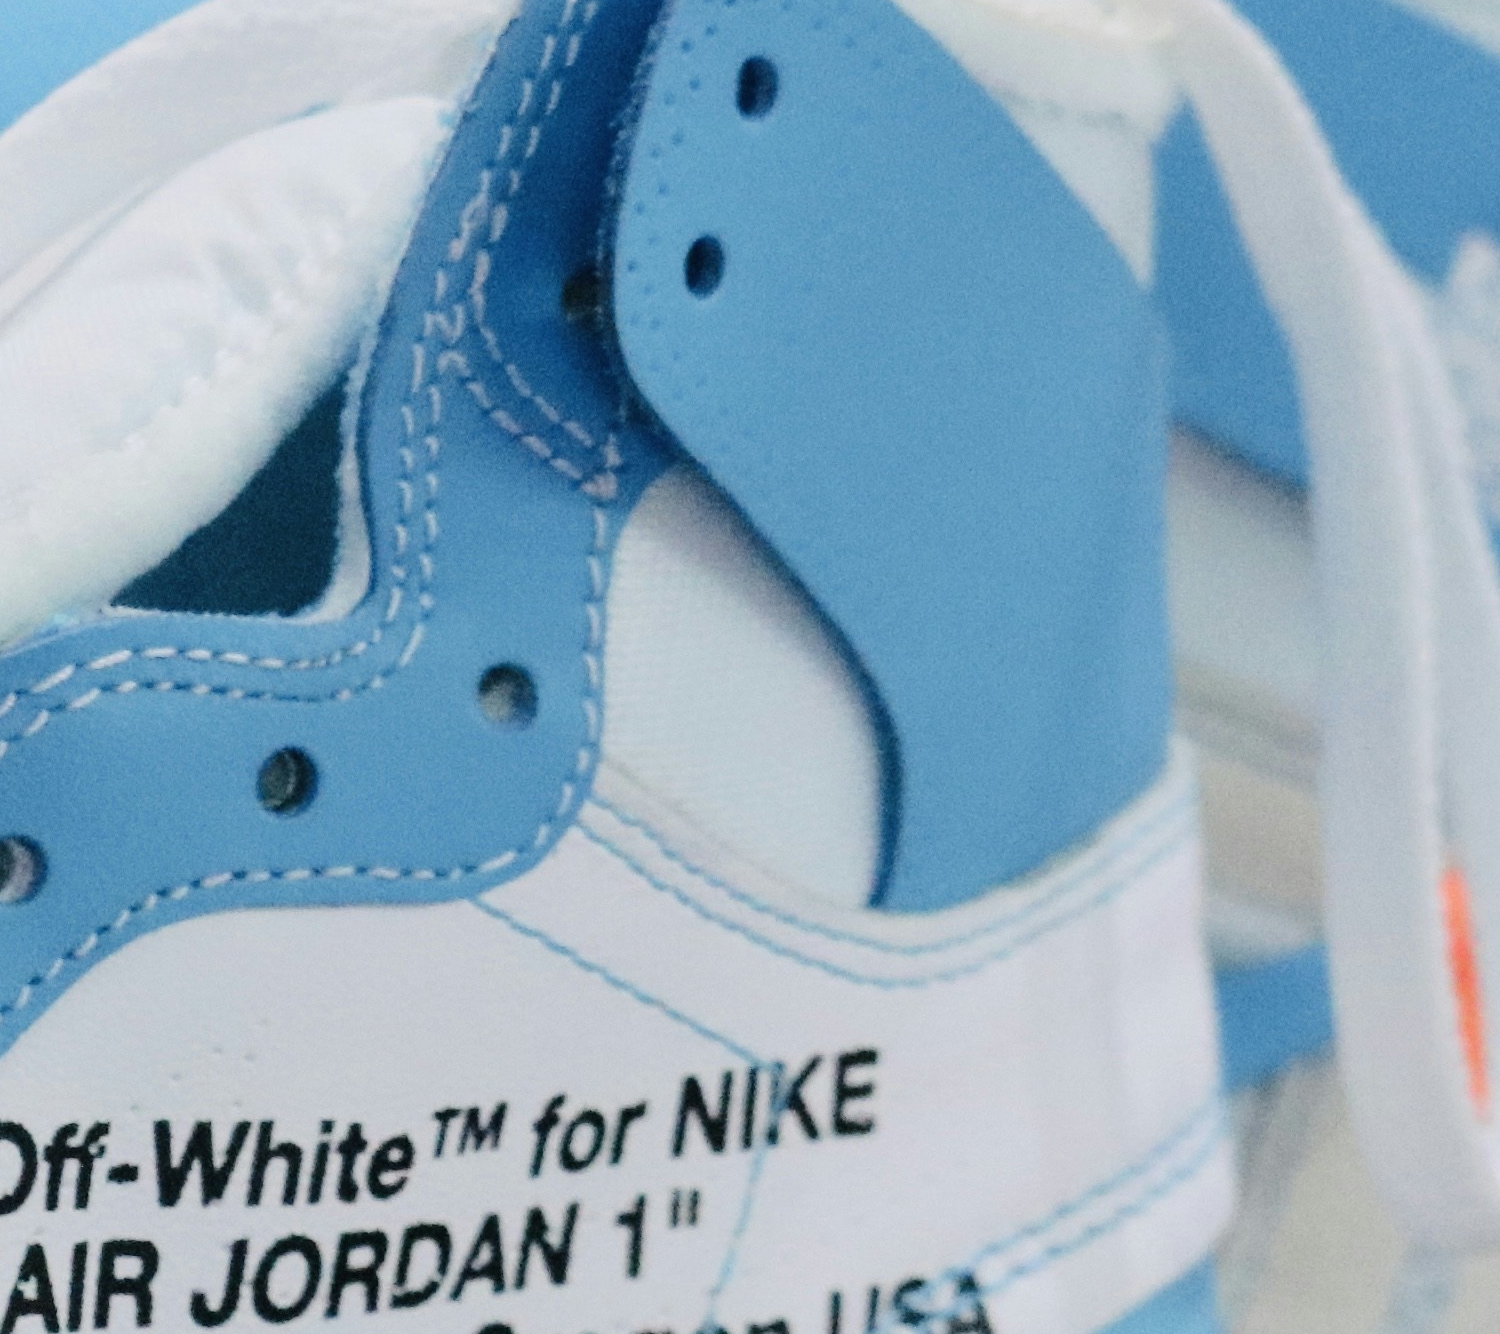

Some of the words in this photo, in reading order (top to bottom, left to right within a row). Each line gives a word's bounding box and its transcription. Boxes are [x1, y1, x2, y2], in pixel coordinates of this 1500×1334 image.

[529, 1093, 649, 1177] for
[671, 1047, 880, 1158] NIKE
[188, 1201, 580, 1330] JORDAN
[616, 1189, 702, 1279] 1"
